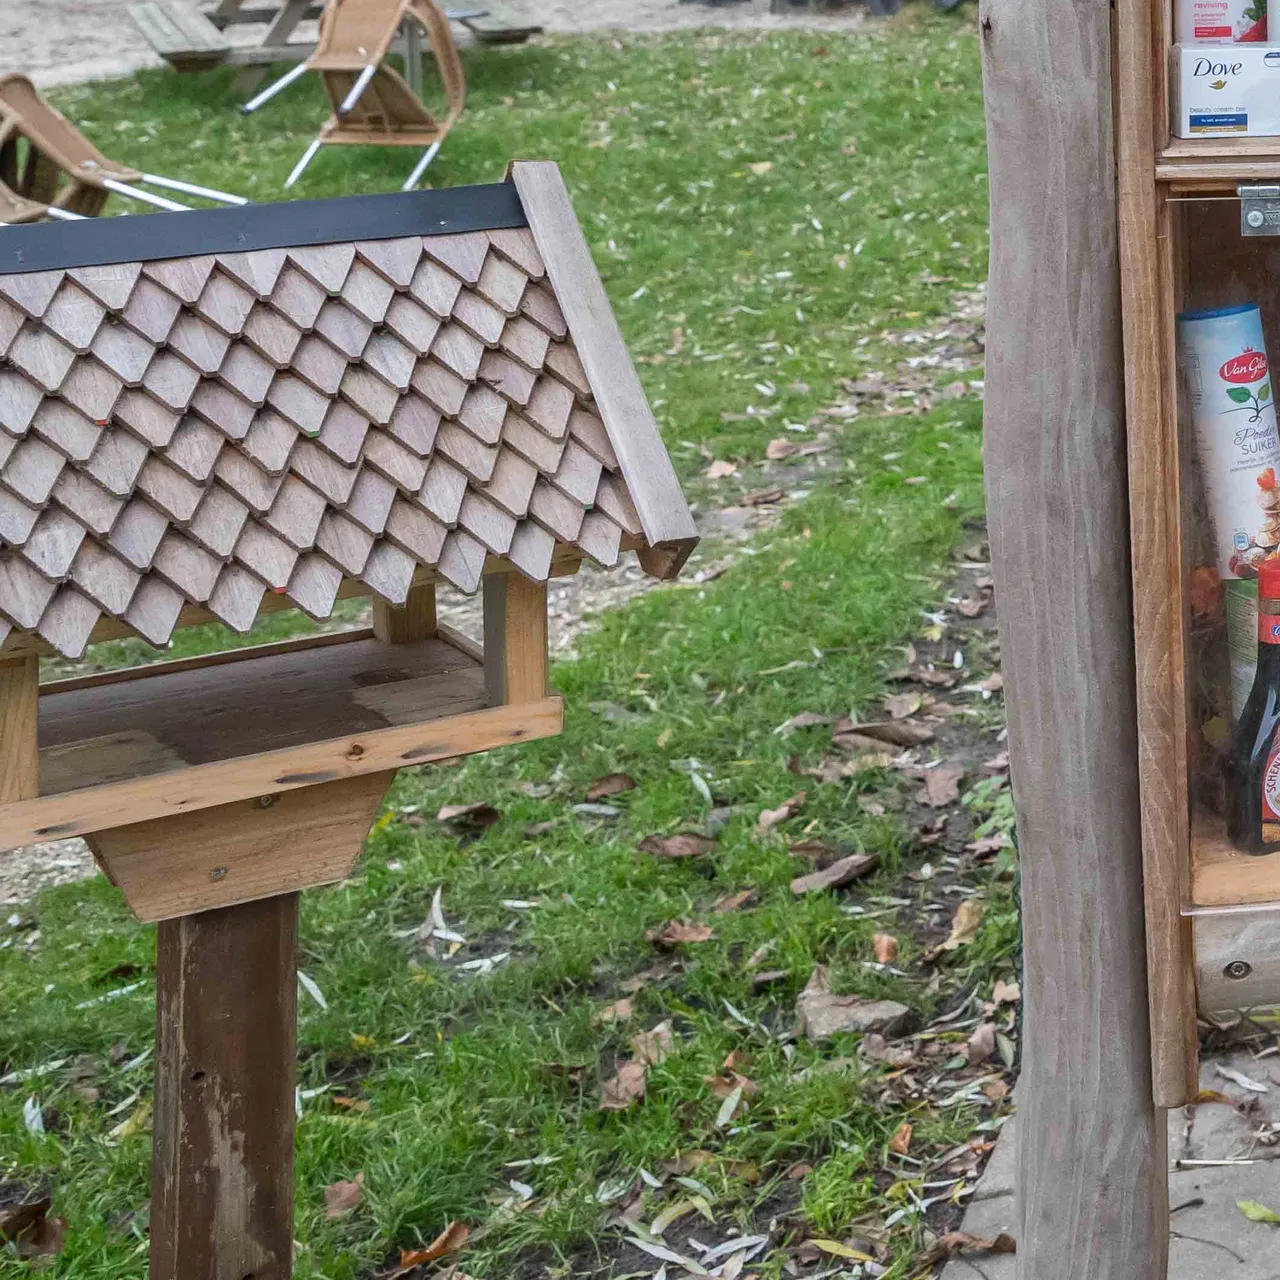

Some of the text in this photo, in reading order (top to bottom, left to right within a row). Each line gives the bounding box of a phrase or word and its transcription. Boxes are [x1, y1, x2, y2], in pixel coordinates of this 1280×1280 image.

[1194, 2, 1228, 10] reviving
[1193, 57, 1242, 76] Dove
[1224, 363, 1248, 378] Van
